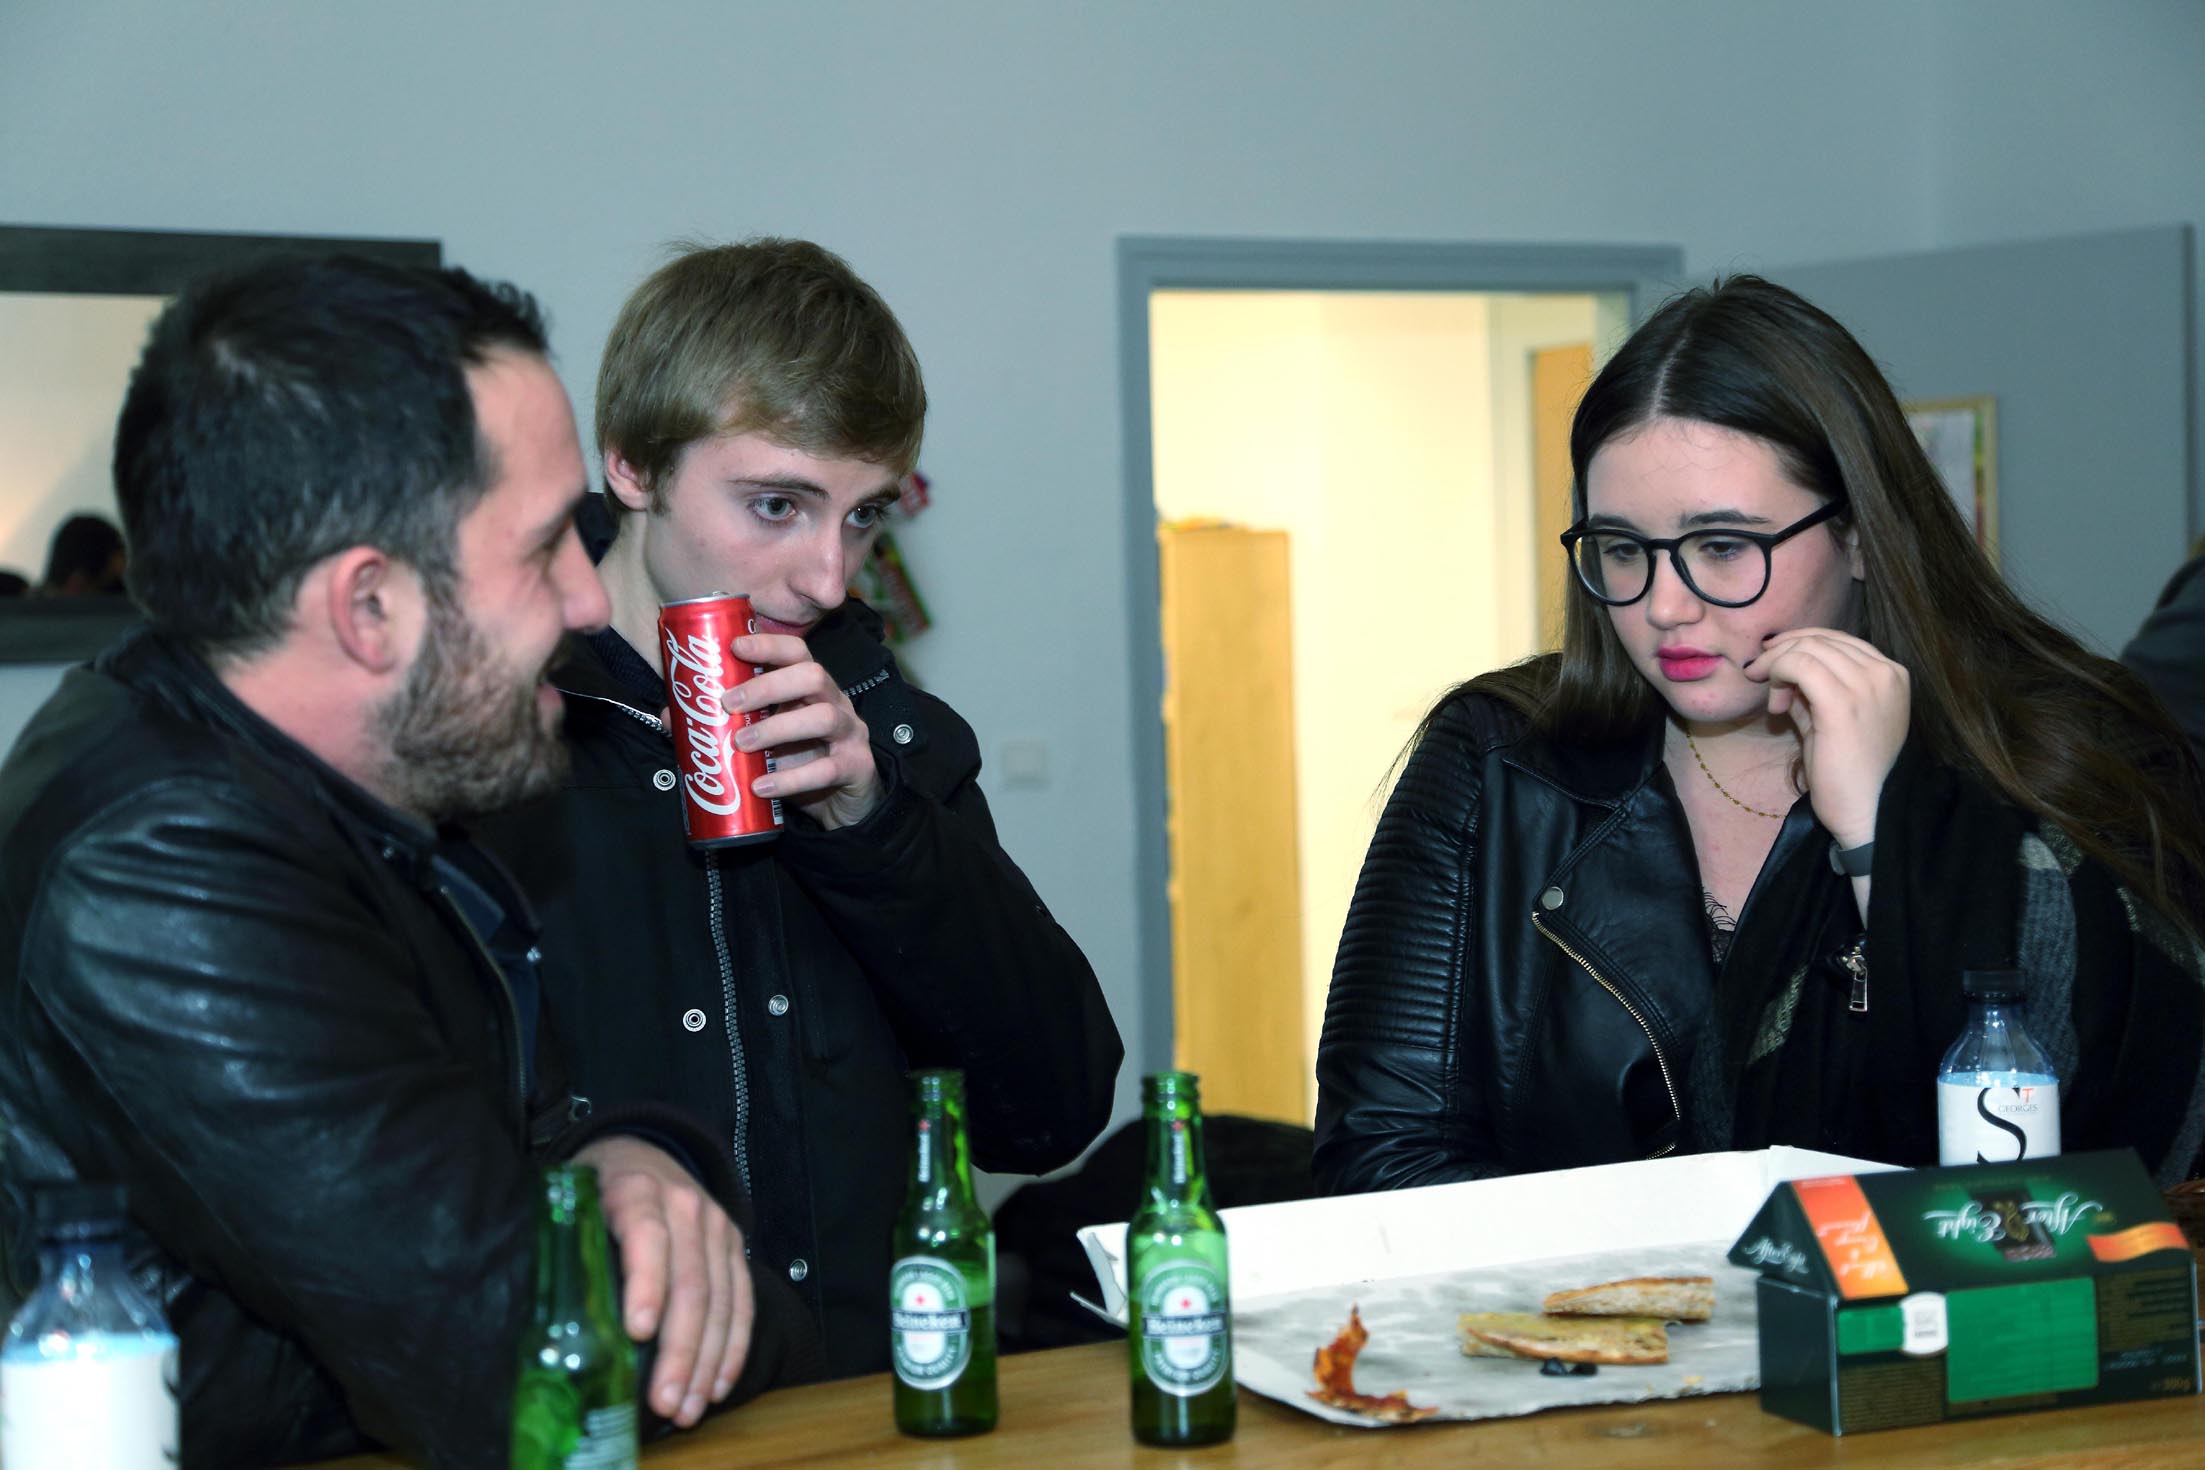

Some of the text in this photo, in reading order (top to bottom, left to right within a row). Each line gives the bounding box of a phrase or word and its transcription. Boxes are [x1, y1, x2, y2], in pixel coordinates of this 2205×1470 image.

[664, 626, 741, 816] Coca-Cola
[1922, 1191, 2103, 1243] After Eight
[892, 1311, 963, 1331] Heineken
[1145, 1314, 1225, 1337] Heineken
